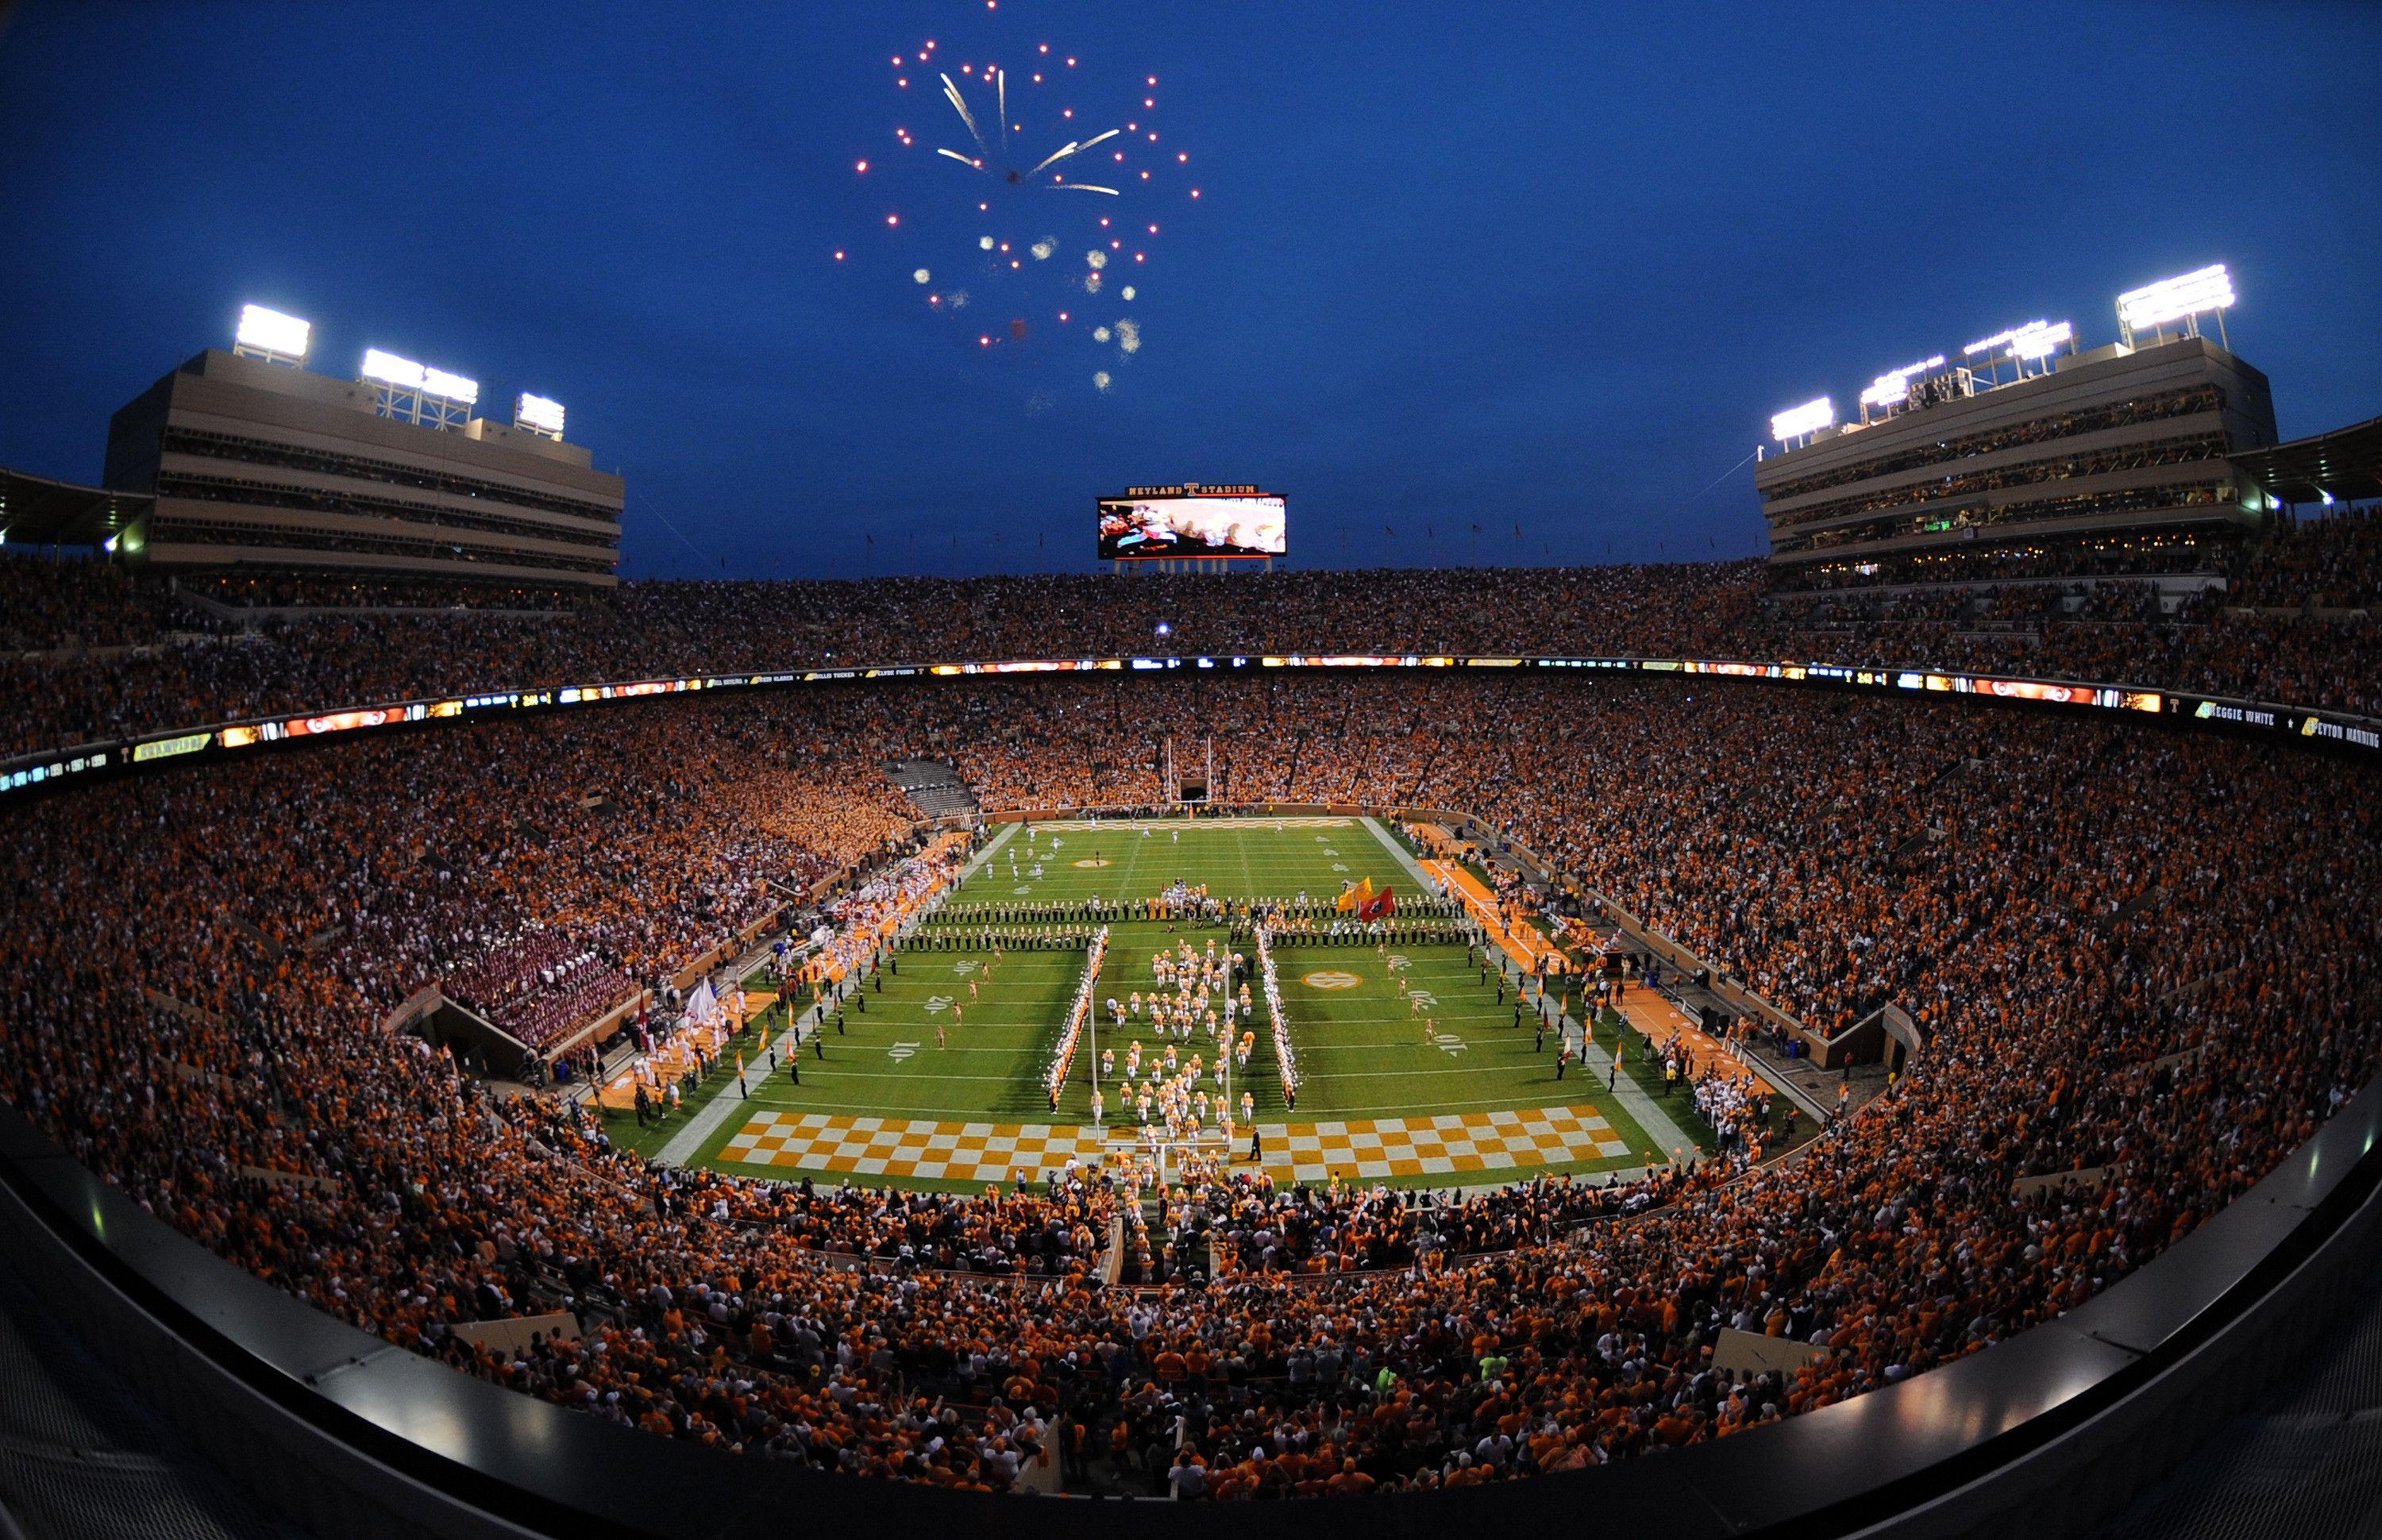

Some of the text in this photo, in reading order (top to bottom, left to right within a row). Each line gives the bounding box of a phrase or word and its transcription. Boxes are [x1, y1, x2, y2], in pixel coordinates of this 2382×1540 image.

[1129, 483, 1255, 496] NEYLAND T STADIUM
[2210, 705, 2274, 726] REGGIE WHITE
[2346, 727, 2379, 748] MANNING
[954, 961, 978, 972] 30
[923, 995, 953, 1010] 20
[888, 1041, 920, 1058] 10
[1433, 1034, 1468, 1051] 10
